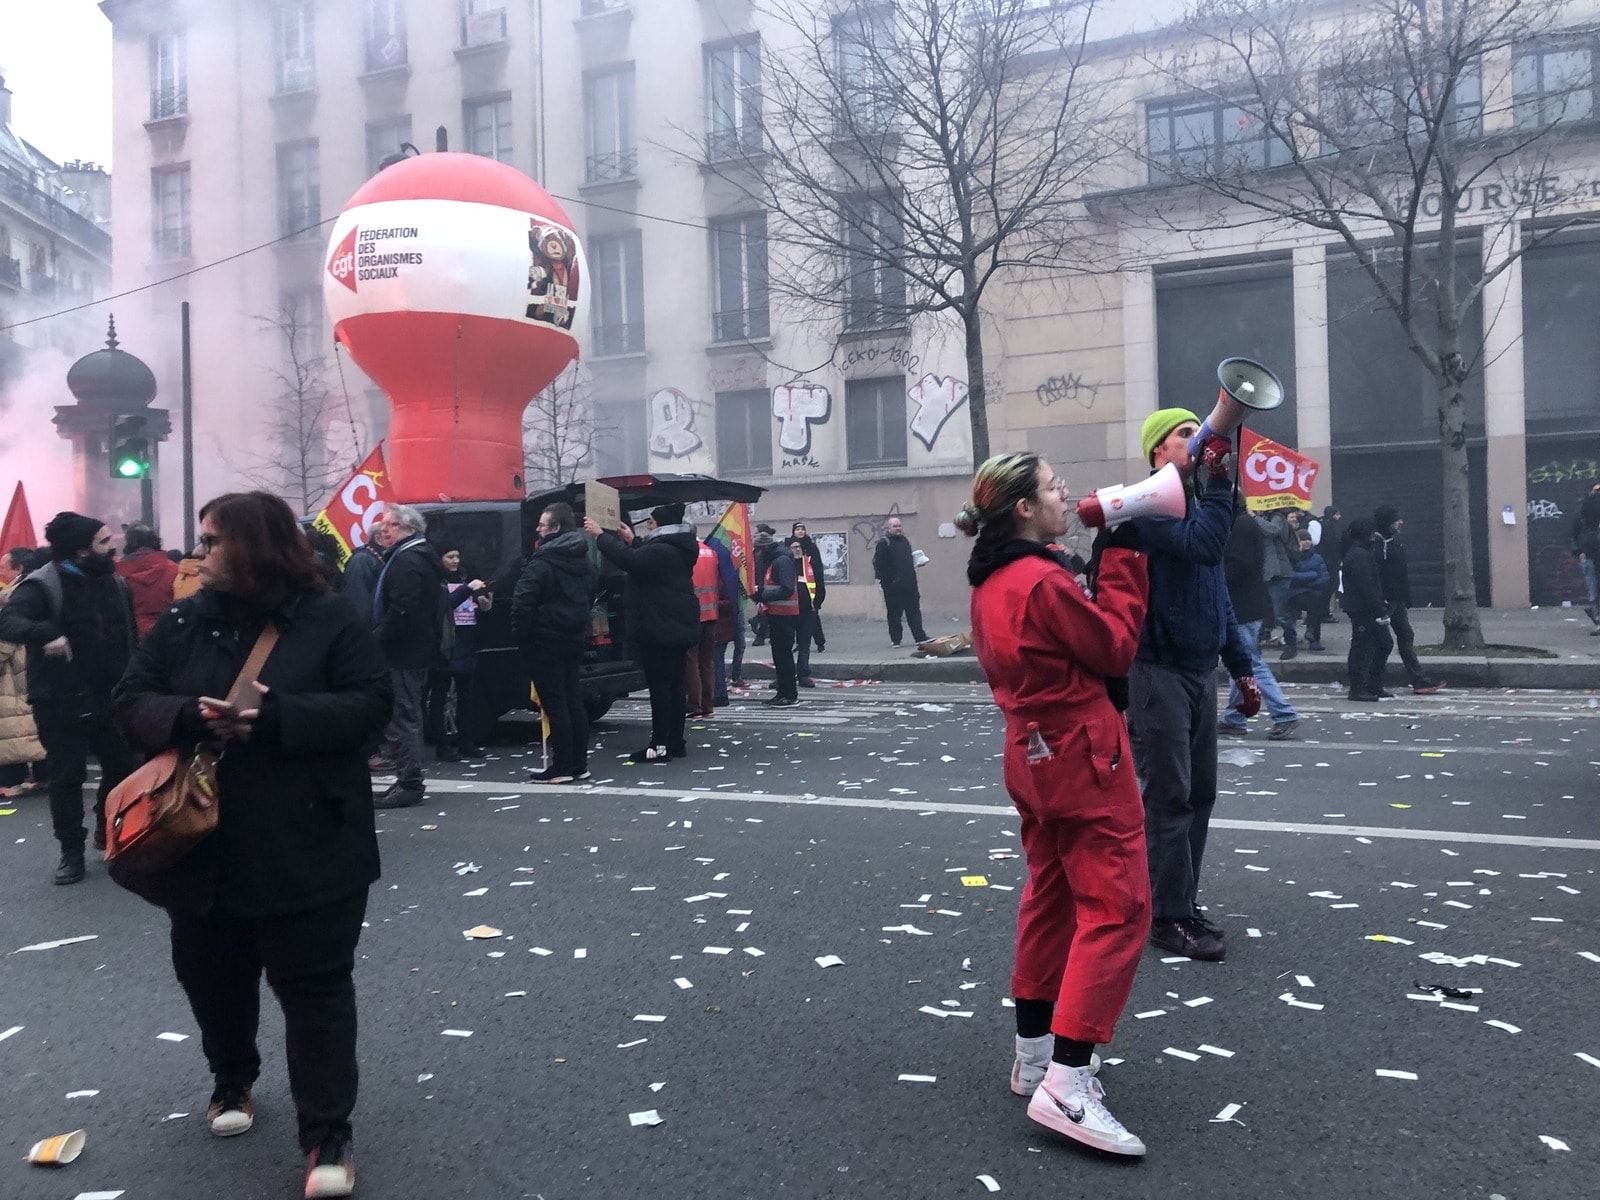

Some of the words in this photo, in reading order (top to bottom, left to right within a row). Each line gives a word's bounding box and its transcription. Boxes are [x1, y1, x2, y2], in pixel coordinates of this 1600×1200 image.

[359, 227, 418, 242] FÉDÉRATION
[358, 242, 376, 254] DES
[332, 251, 354, 278] cgt
[358, 252, 423, 267] ORGANISMES
[358, 266, 398, 281] SOCIAUX
[1246, 453, 1316, 493] cgt
